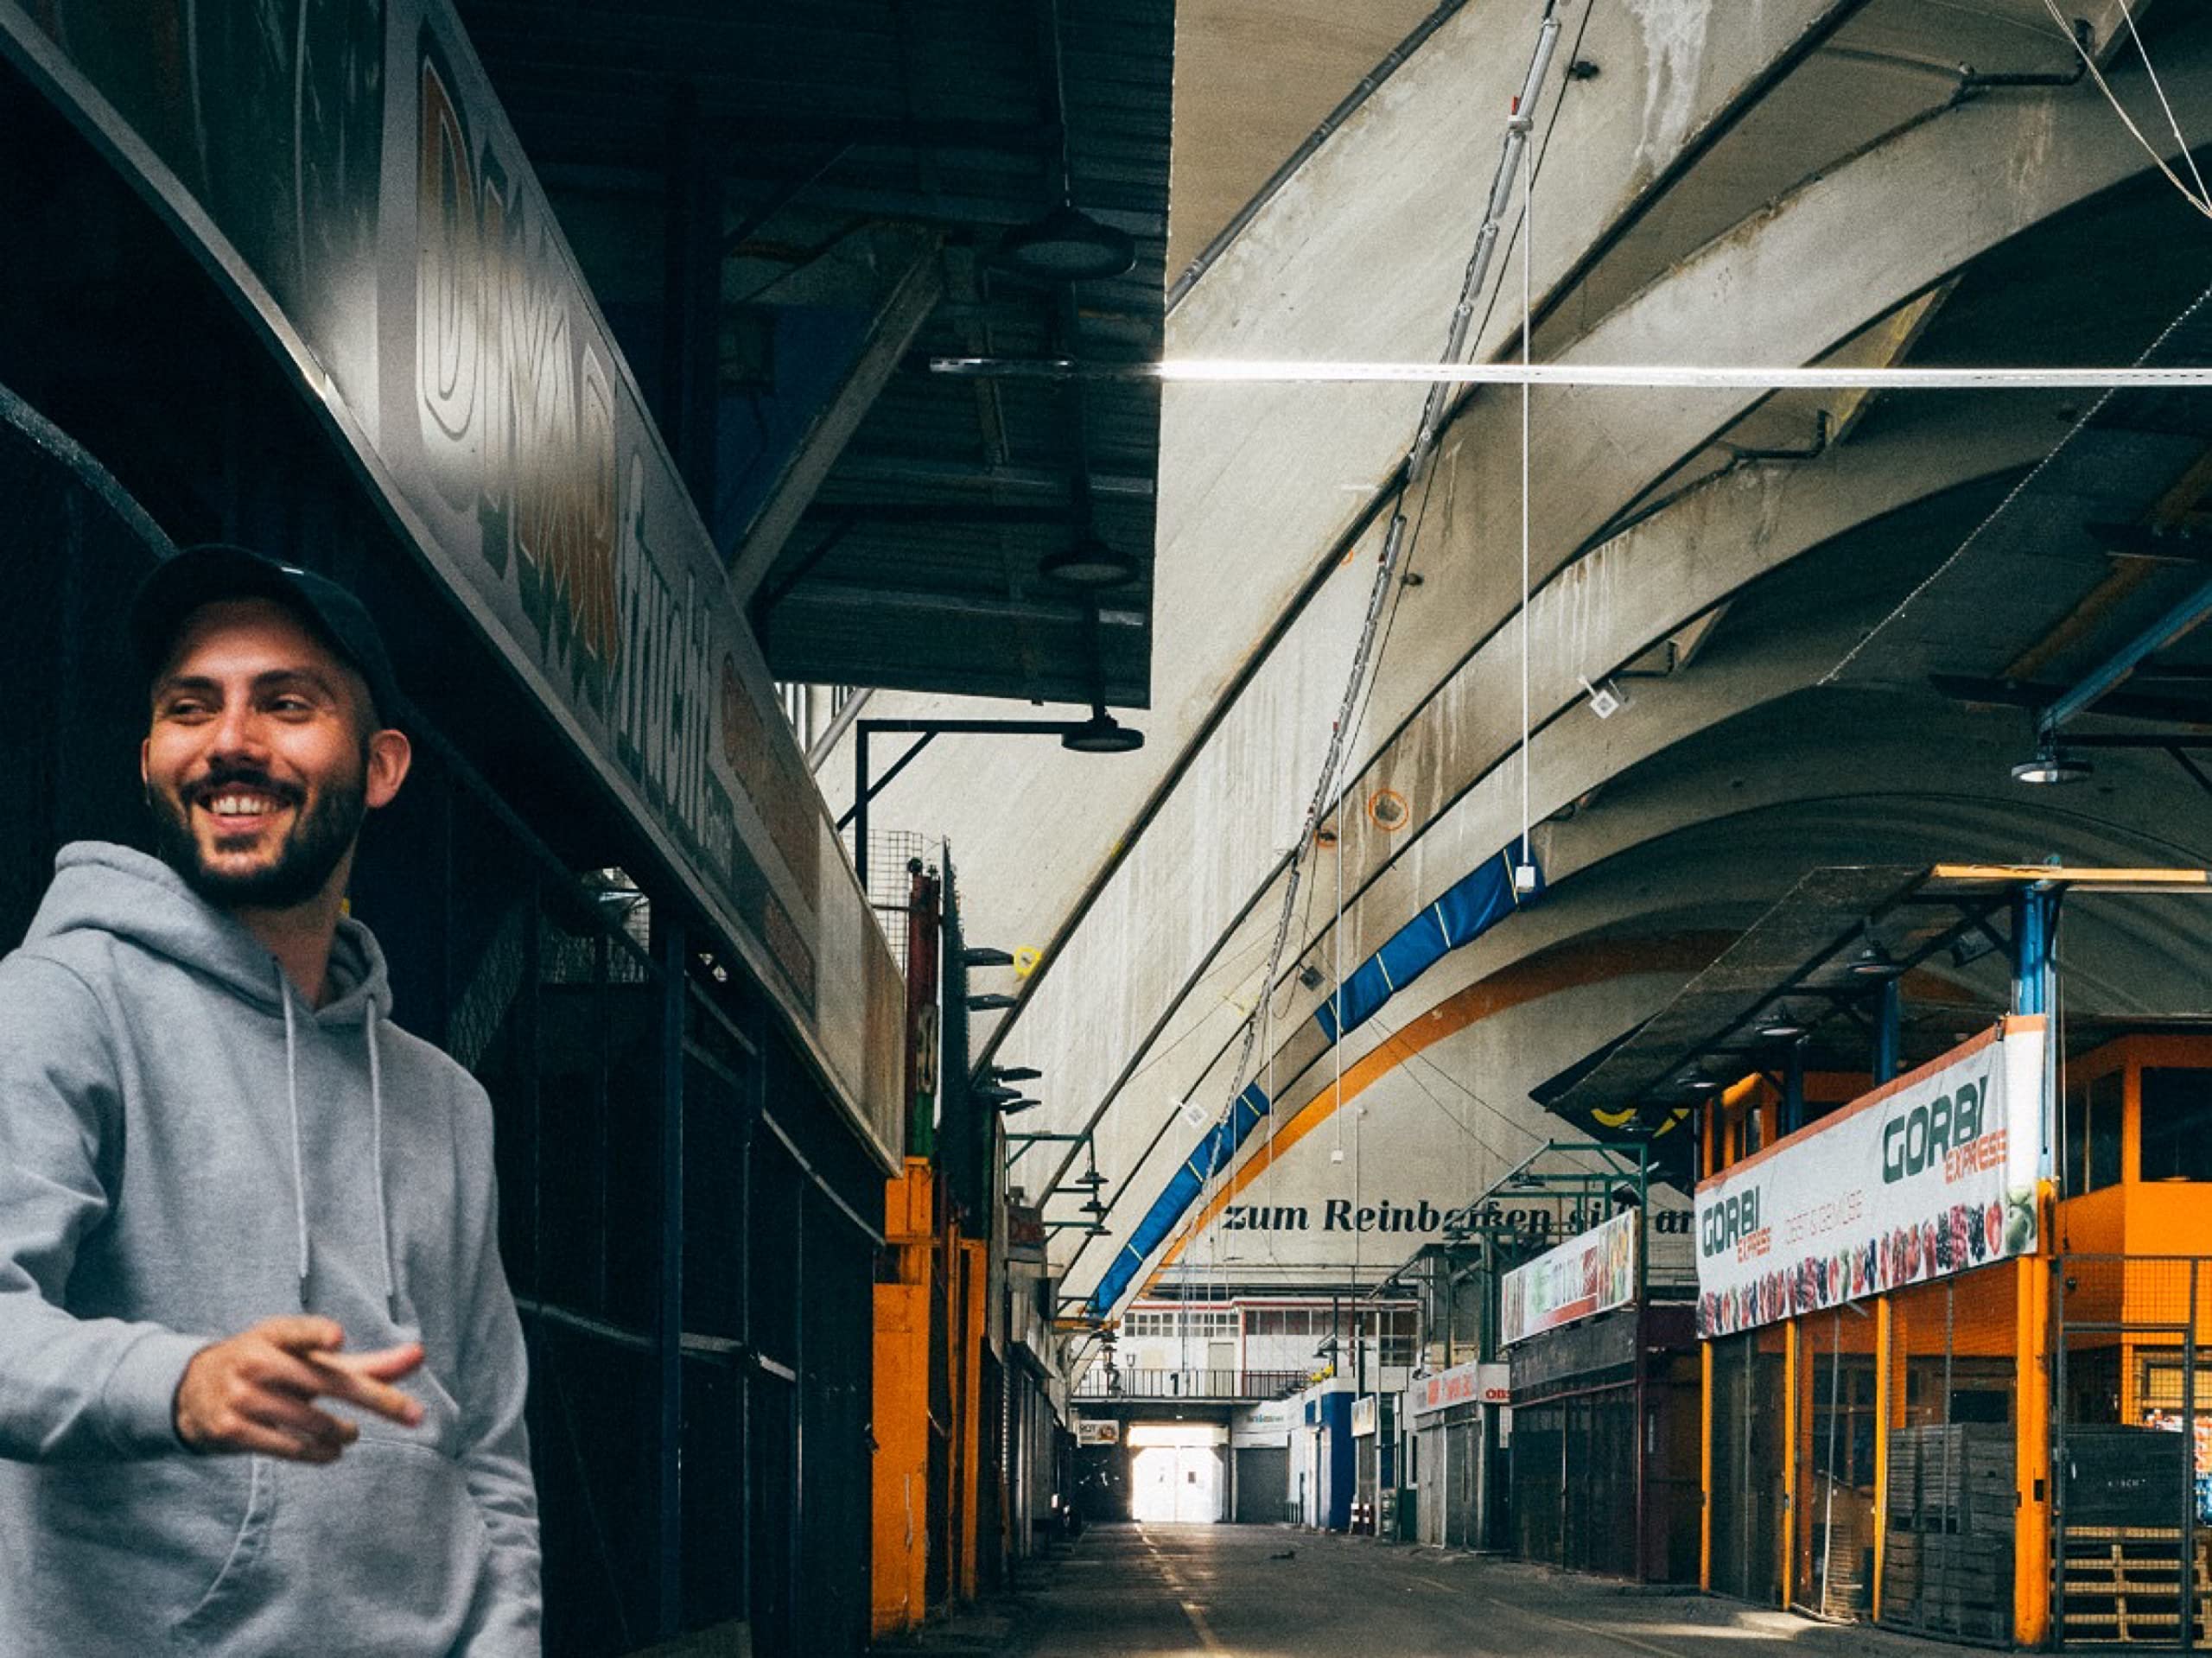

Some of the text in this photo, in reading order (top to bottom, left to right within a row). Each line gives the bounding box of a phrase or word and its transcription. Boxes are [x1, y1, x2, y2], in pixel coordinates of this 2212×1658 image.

[1883, 1075, 1988, 1185] GORBI
[1945, 1128, 2006, 1185] EXPRESS
[1222, 1204, 1310, 1230] zum
[1702, 1185, 1760, 1258] GORBI
